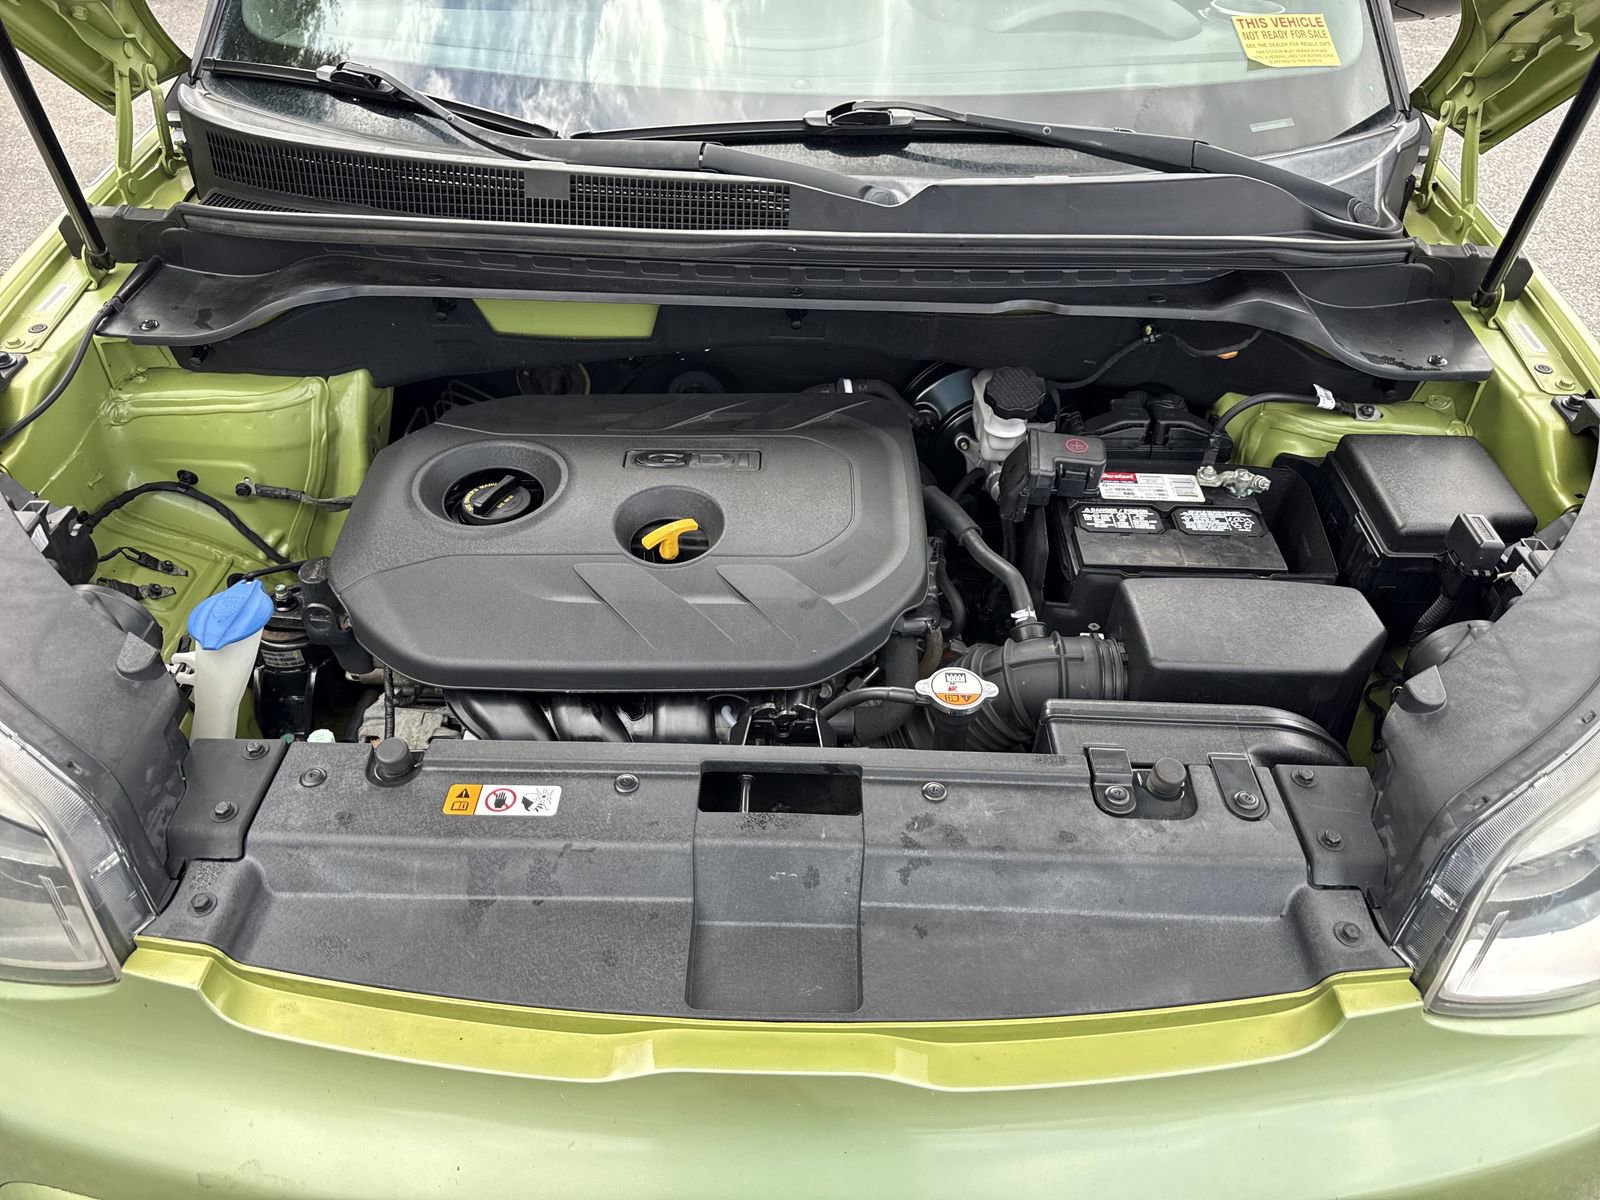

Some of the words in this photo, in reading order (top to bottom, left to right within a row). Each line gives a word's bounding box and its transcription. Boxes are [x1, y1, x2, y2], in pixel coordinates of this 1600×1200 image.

[1236, 17, 1268, 29] THIS
[1270, 16, 1324, 28] VEHICLE
[1242, 31, 1260, 41] NOT
[1262, 30, 1288, 40] READY
[1290, 30, 1306, 39] FOR
[1308, 29, 1328, 39] SALE
